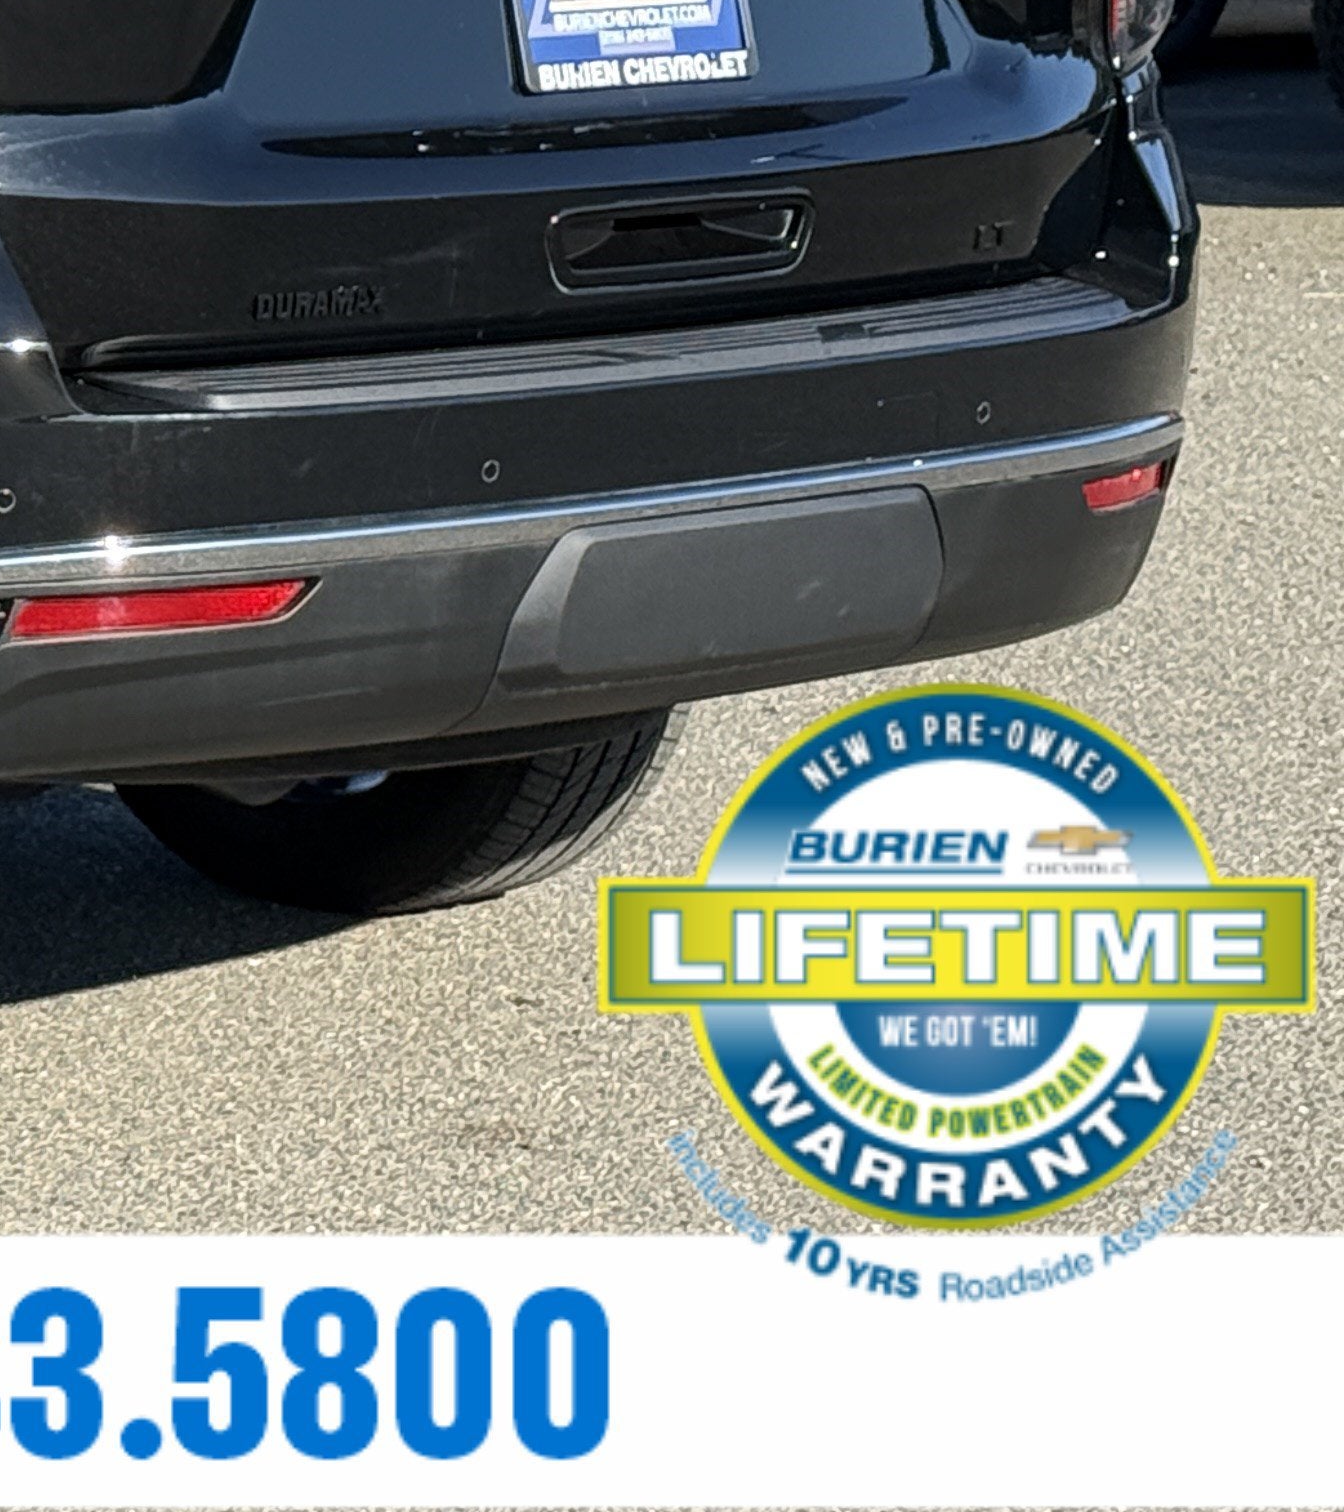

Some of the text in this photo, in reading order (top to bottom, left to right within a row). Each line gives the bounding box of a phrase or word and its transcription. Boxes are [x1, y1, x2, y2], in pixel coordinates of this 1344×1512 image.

[538, 50, 749, 91] BURIEN CHEVROLET
[252, 284, 386, 321] DURAMAX
